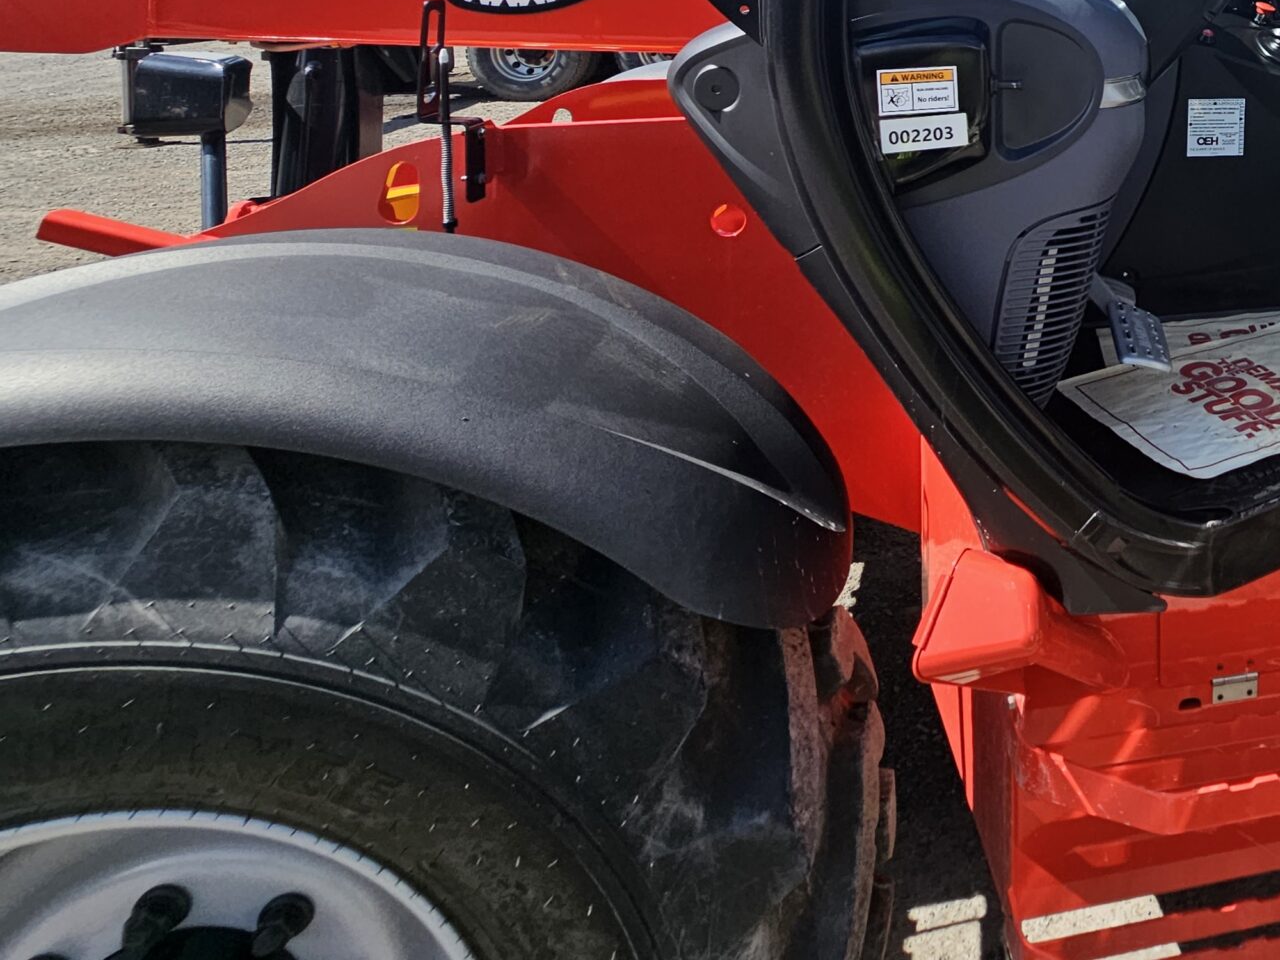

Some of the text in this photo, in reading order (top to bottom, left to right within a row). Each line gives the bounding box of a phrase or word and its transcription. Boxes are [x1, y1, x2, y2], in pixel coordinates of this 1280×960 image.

[901, 72, 944, 81] WARNING
[928, 95, 950, 103] riders!
[888, 126, 954, 145] 002203
[1197, 137, 1219, 146] OEH
